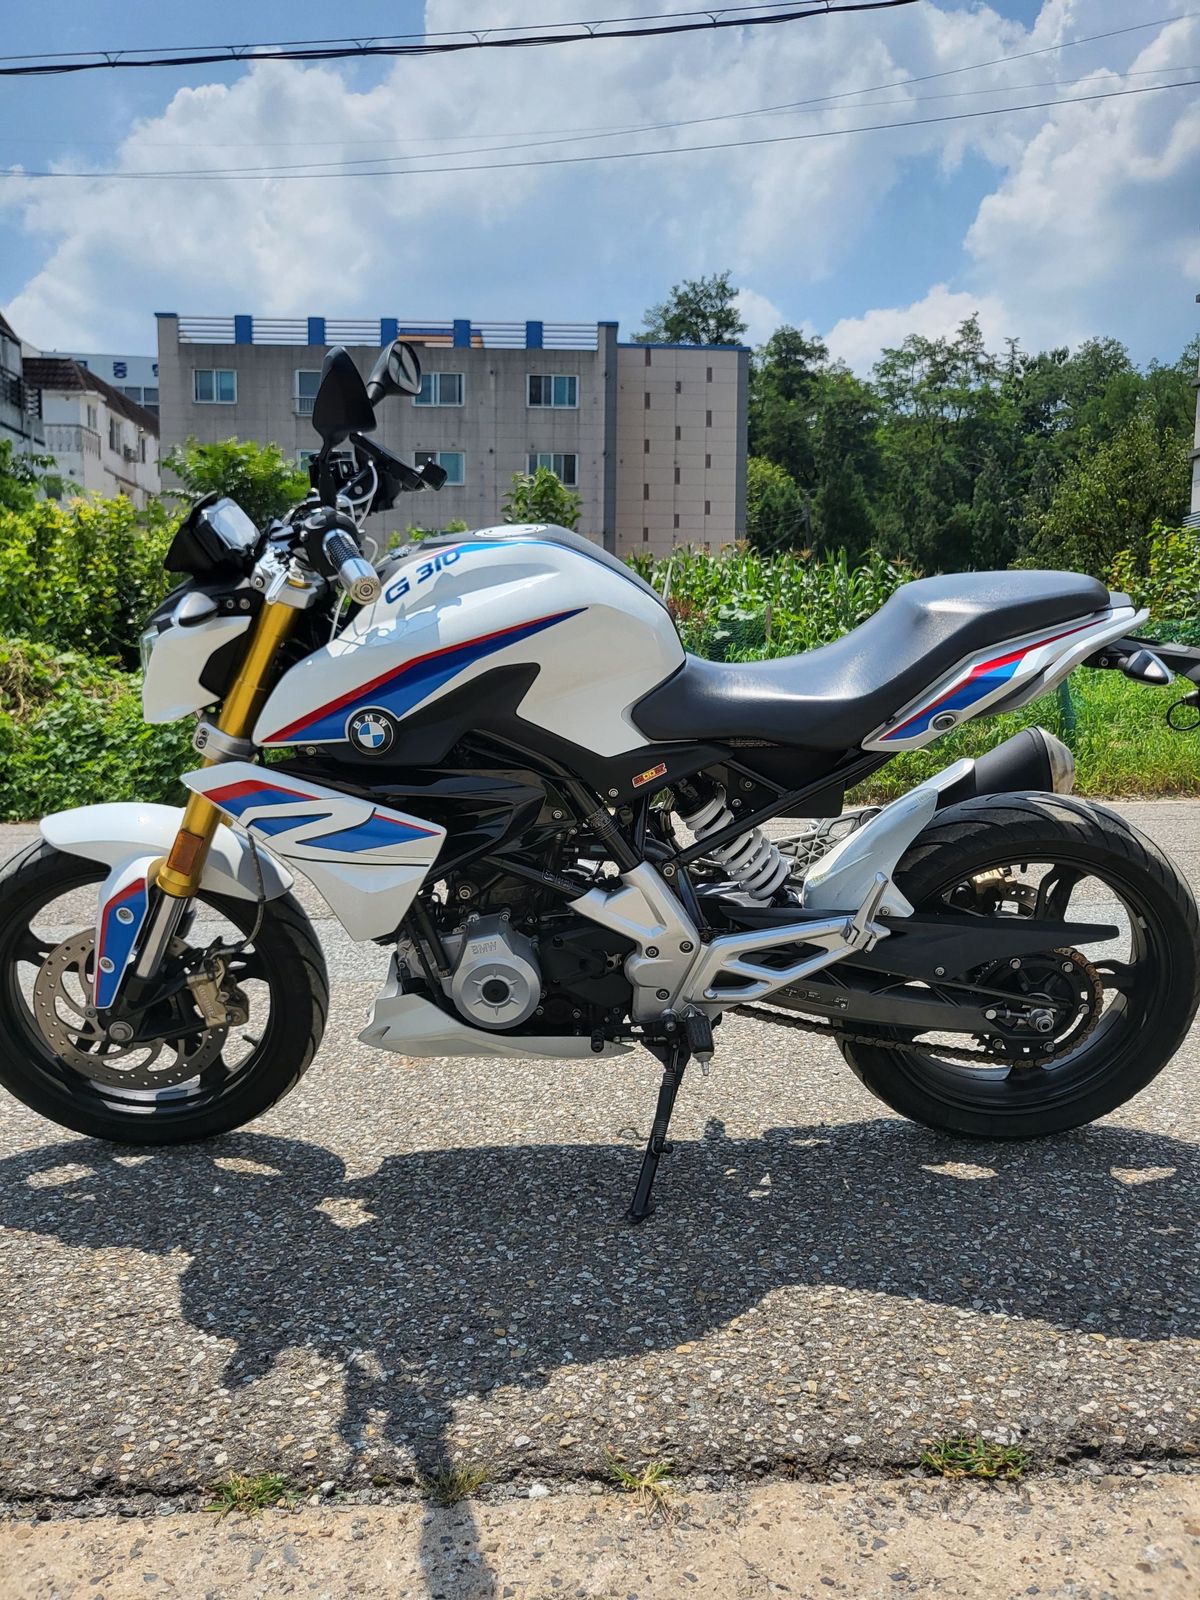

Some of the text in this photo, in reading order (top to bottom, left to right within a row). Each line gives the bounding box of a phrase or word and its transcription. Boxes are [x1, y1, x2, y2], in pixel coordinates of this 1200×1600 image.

[385, 550, 461, 604] G 310
[353, 714, 388, 730] BMW
[471, 941, 498, 955] BMW
